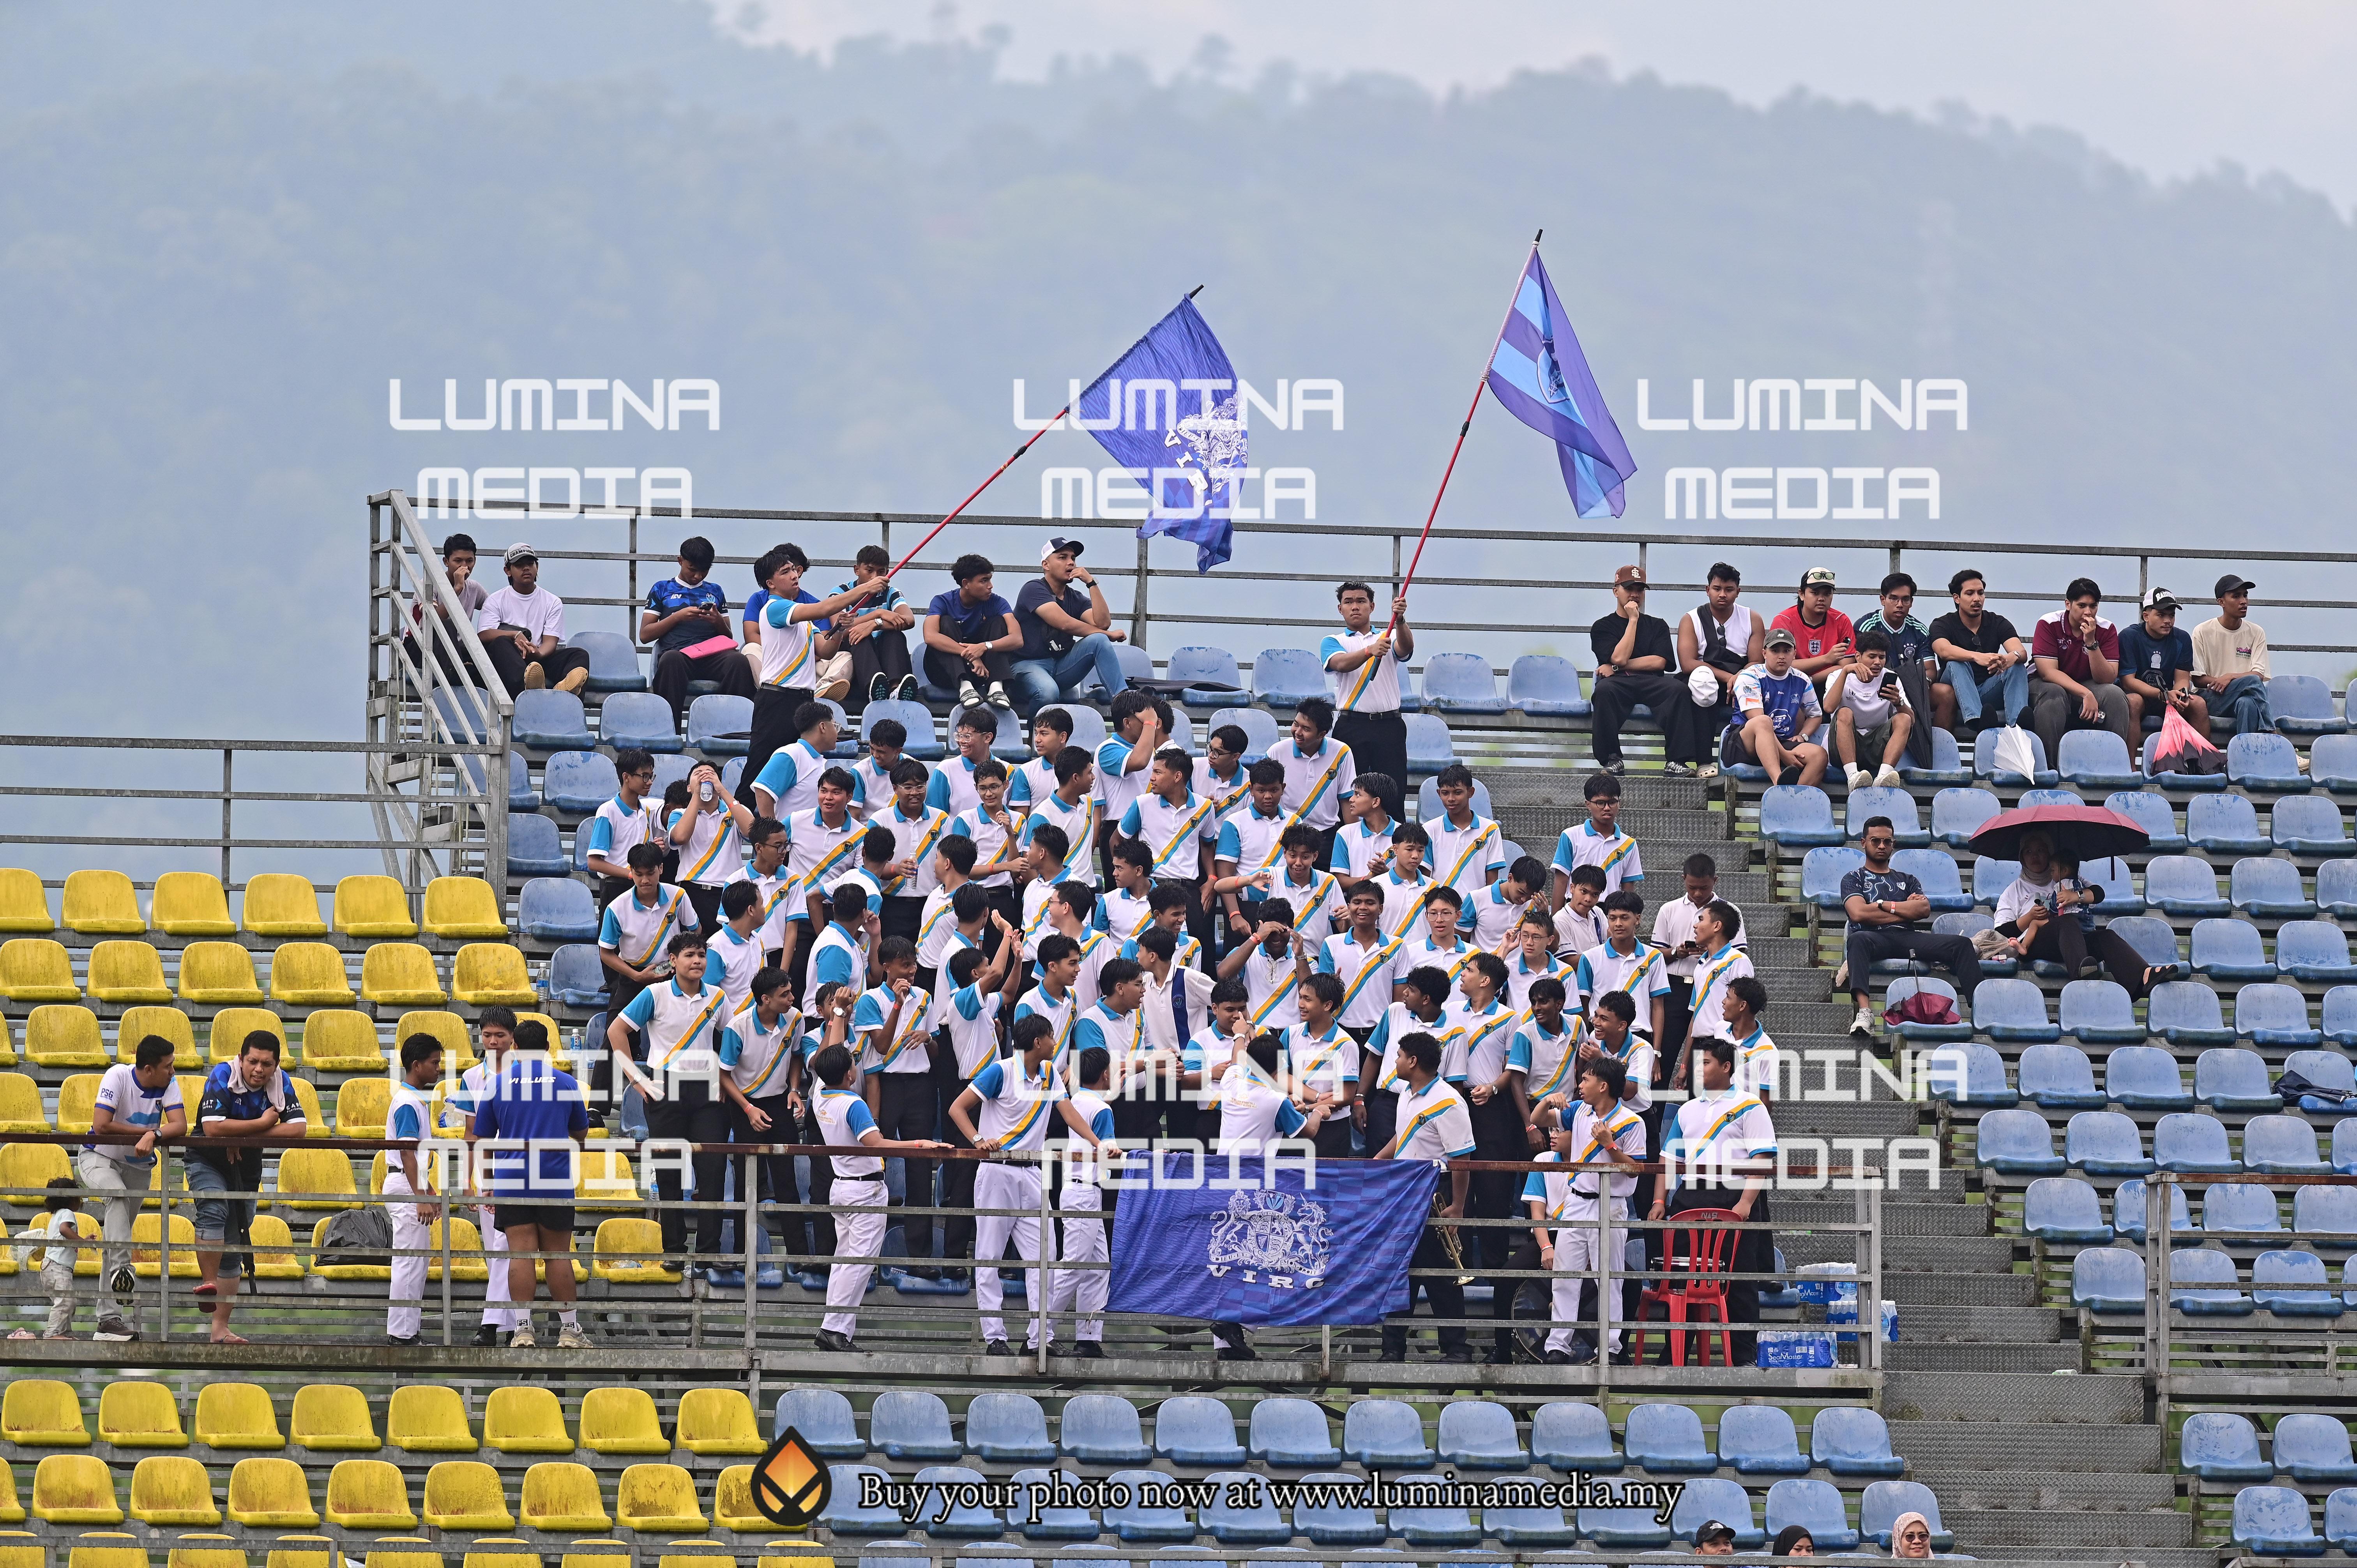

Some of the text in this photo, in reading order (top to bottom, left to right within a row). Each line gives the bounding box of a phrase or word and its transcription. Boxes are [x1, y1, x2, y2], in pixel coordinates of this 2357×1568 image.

[1164, 428, 1212, 506] VIR
[101, 1088, 114, 1098] PSG
[1207, 1264, 1325, 1289] VIRC
